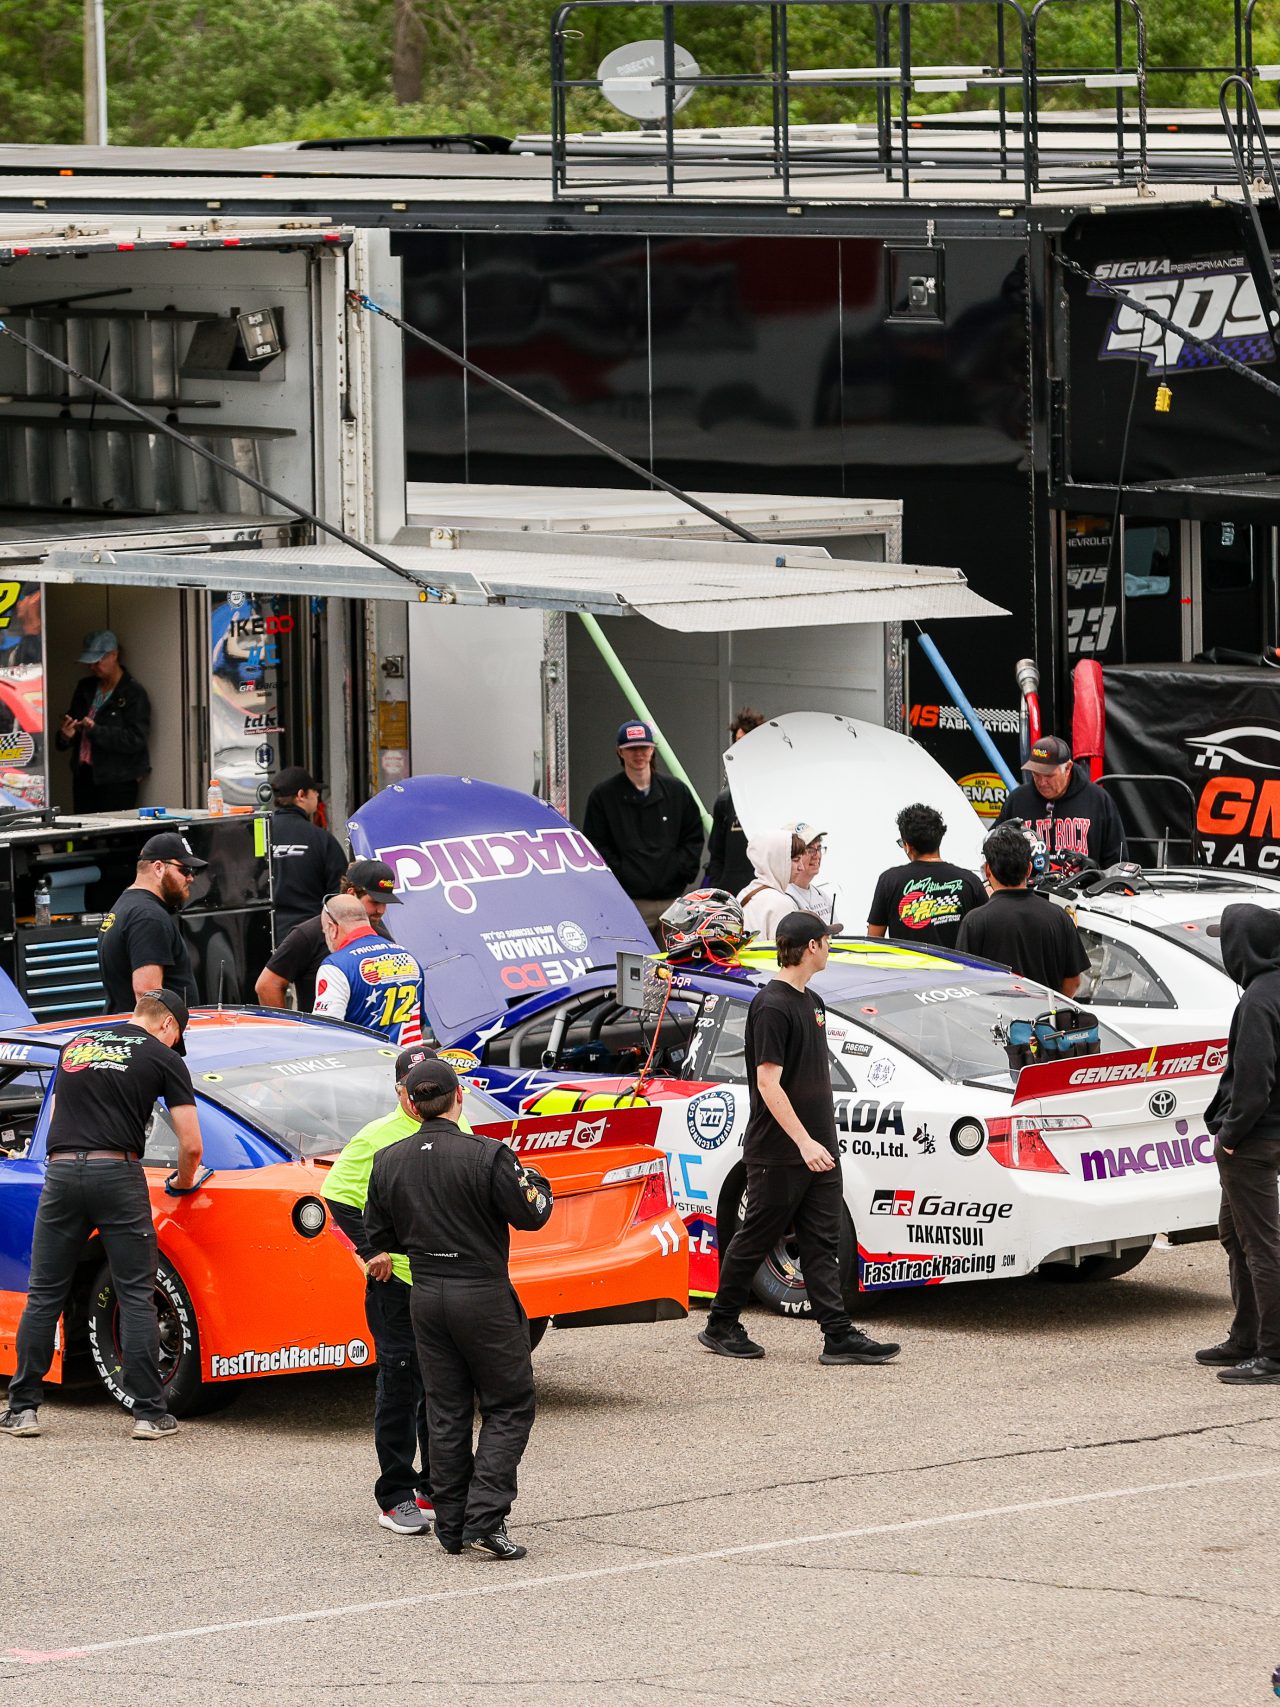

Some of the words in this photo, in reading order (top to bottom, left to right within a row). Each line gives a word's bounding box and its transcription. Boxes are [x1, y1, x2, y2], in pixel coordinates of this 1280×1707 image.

[1095, 259, 1170, 279] SIGMA
[1170, 257, 1244, 272] PERFORMANCE
[1066, 536, 1113, 547] HEVROLET
[230, 615, 294, 637] IKEDO
[1067, 606, 1117, 653] 23
[244, 715, 278, 729] tdk
[961, 786, 1010, 803] ENAR
[376, 829, 610, 914] MACNIC
[485, 935, 565, 960] YAMADA
[500, 957, 594, 990] IKEDO
[670, 976, 692, 988] OGA
[379, 985, 417, 1027] 12
[913, 986, 980, 1005] KOGA
[271, 1057, 347, 1075] TINKLE
[1069, 1061, 1157, 1085] GENERAL
[1158, 1054, 1203, 1076] TIRE
[834, 1099, 906, 1135] ADA
[524, 1129, 573, 1150] TIRE
[852, 1140, 909, 1160] CO.,Ltd.
[1080, 1119, 1223, 1182] MACNIC
[674, 1202, 713, 1215] YSTEMS
[918, 1195, 1013, 1223] Garage
[907, 1224, 984, 1247] TAKATSUJI
[864, 1253, 996, 1284] FastTrackRacing
[156, 1268, 192, 1355] ENERAL
[211, 1342, 347, 1378] FastTrackRacing
